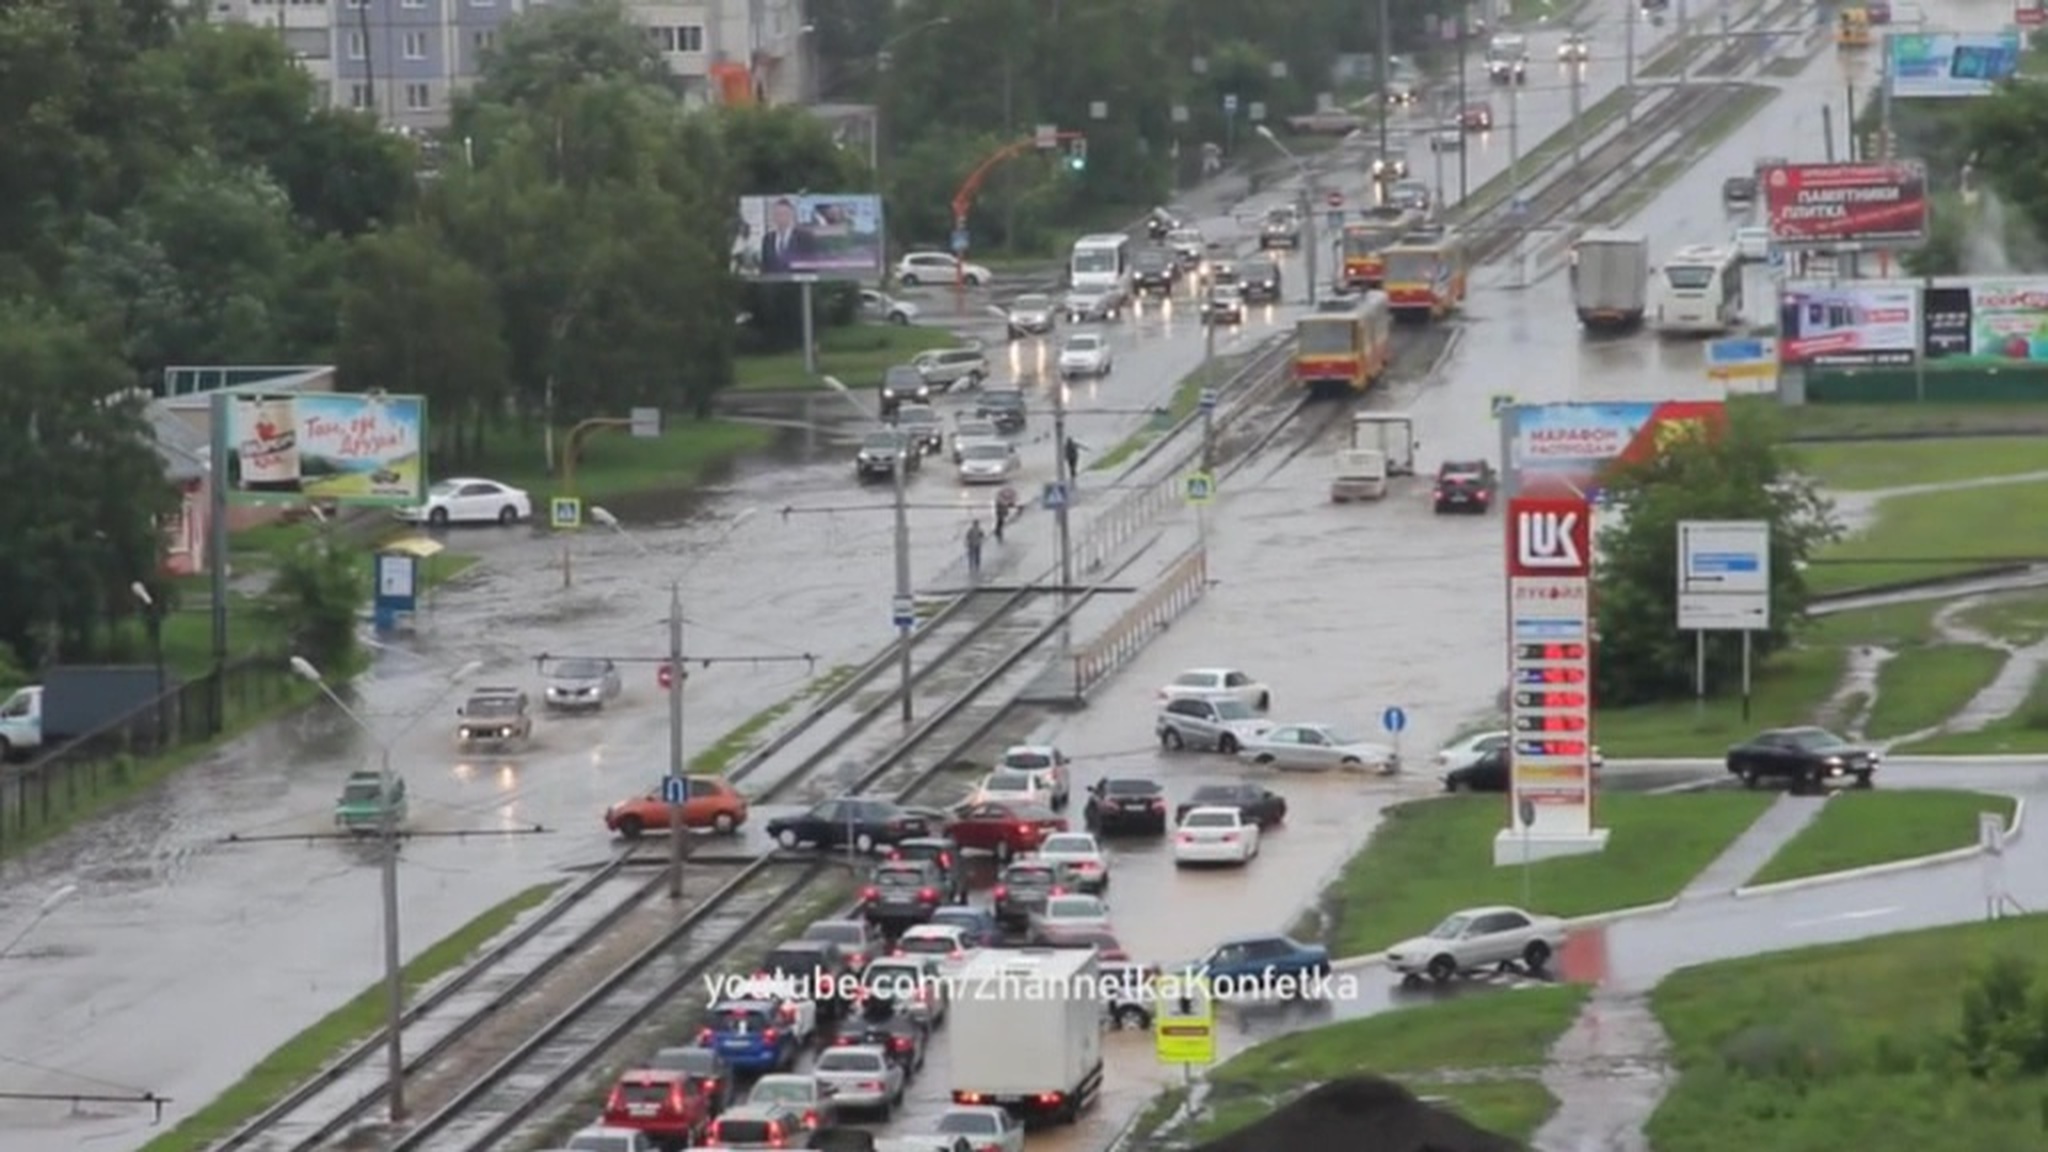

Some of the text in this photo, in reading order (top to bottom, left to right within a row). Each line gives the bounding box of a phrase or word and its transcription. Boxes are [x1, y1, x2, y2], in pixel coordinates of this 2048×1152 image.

[1798, 186, 1900, 204] ПАМЯТНИКИ
[1781, 204, 1848, 220] ПЛИТКА
[1530, 427, 1618, 442] МАРАФОН
